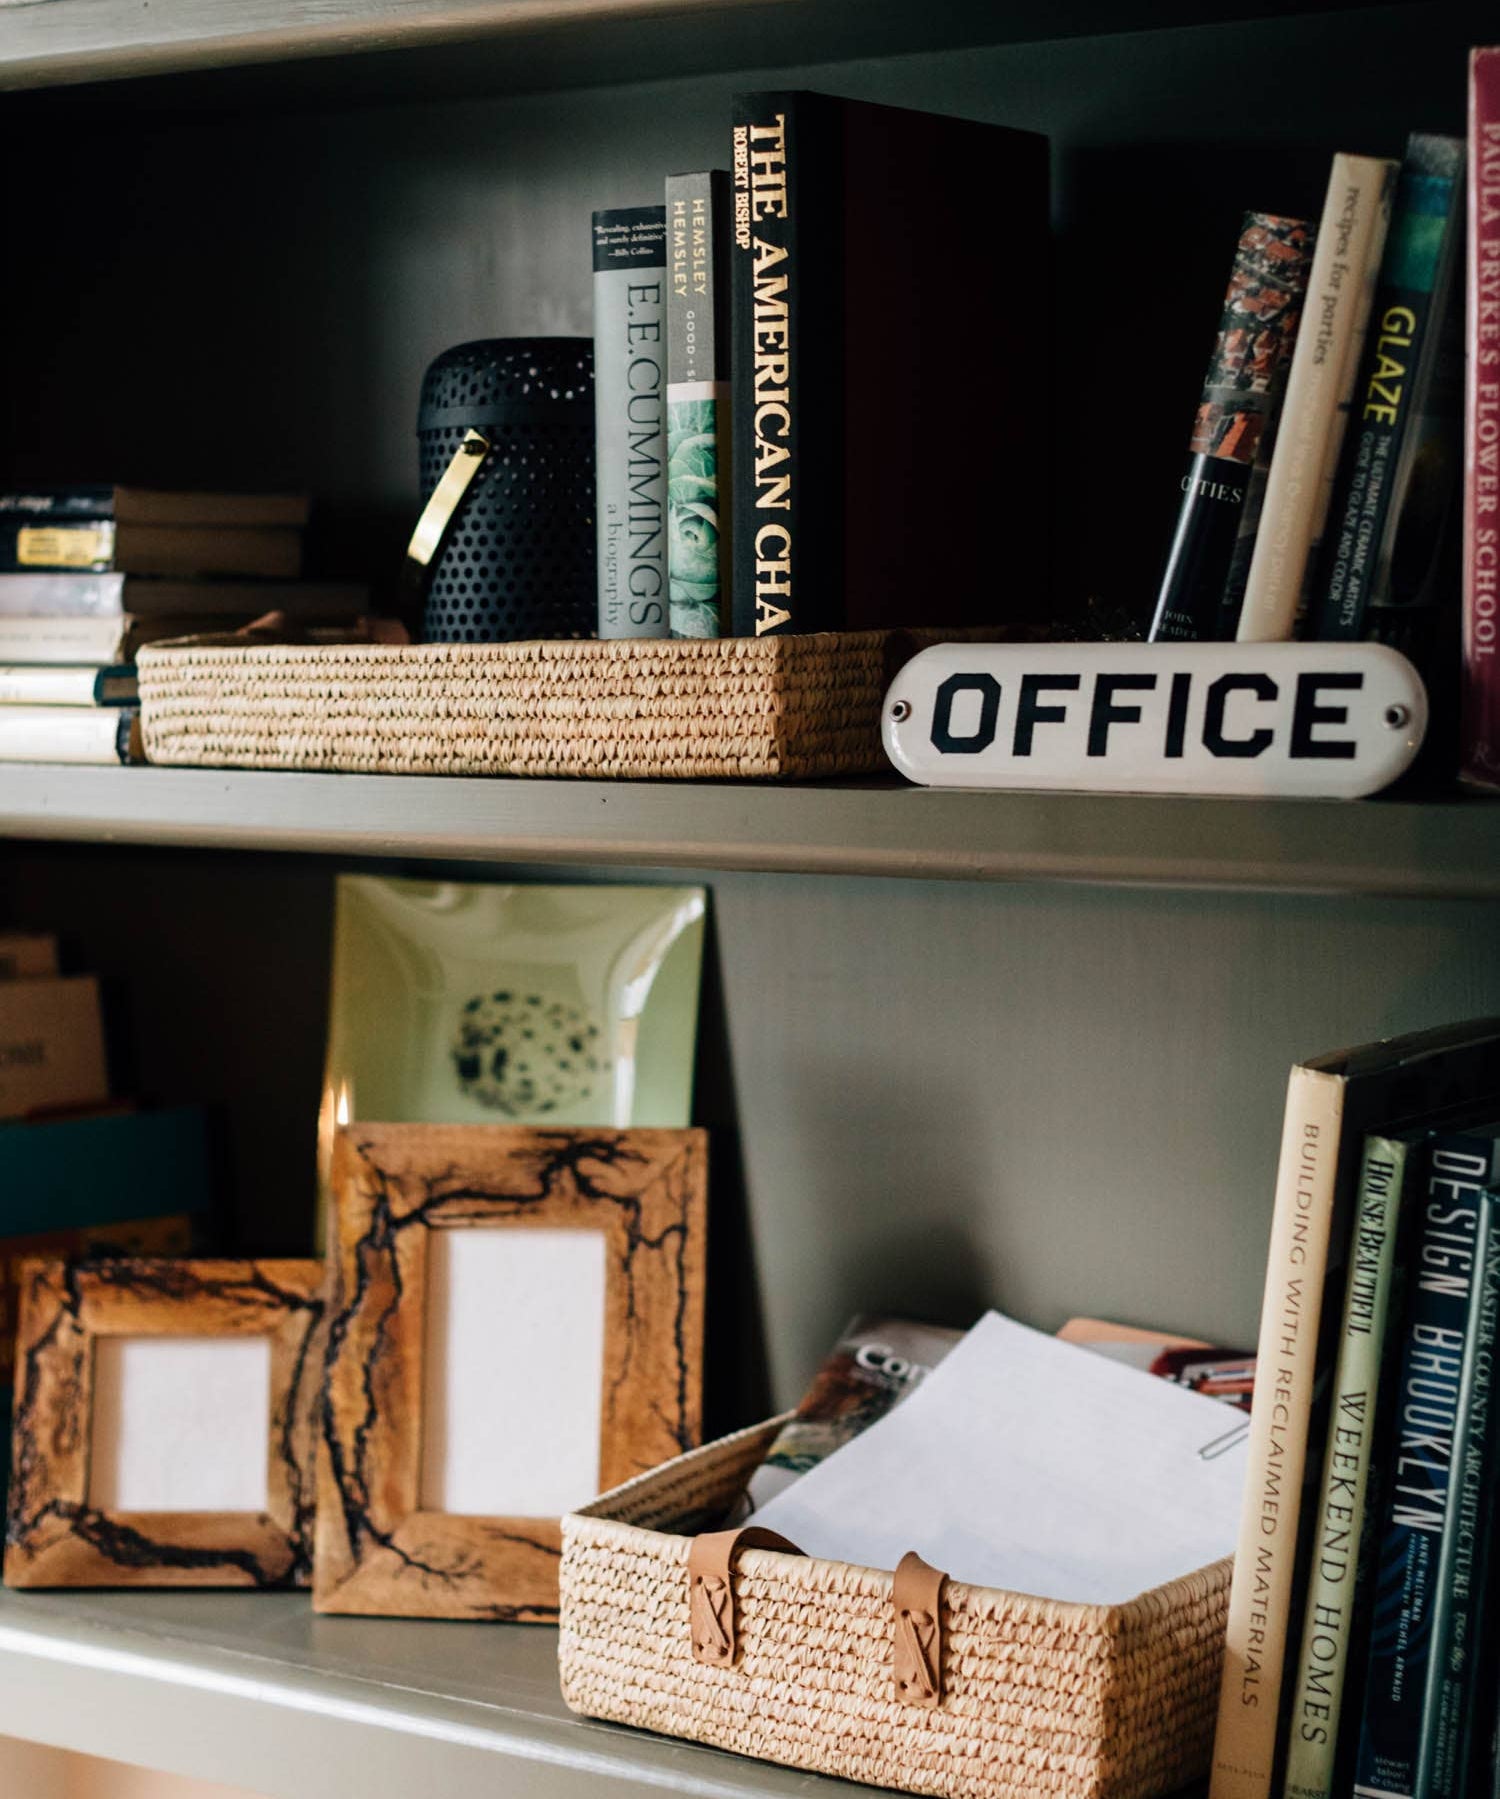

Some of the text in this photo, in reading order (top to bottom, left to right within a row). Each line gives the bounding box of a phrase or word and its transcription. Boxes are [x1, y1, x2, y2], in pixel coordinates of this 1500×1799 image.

[733, 126, 751, 250] ROBERT BISHOP
[750, 114, 787, 221] THE
[1482, 122, 1500, 224] PAULA
[674, 201, 687, 297] HEMSLEY
[692, 199, 706, 295] HEMSLEY
[1313, 186, 1360, 366] recipes for parties
[686, 311, 696, 354] GOOD
[752, 236, 791, 511] AMERICAN
[1363, 306, 1416, 426] GLAZE
[1352, 471, 1367, 489] TO
[1358, 431, 1375, 468] GUIDE
[1362, 460, 1385, 517] ULTIMATE
[1375, 435, 1392, 457] THE
[1476, 383, 1500, 515] FLOWER
[605, 523, 624, 626] biography
[1329, 560, 1347, 602] COLOR
[1337, 531, 1353, 559] AND
[1351, 519, 1374, 575] CERAMIC
[1474, 528, 1497, 662] SCHOOL
[930, 672, 1364, 759] OFFICE
[1392, 1150, 1487, 1533] DESIGN BROOKLYN
[1242, 1122, 1320, 1708] BUILDING WITH RECLAIMED MATERIALS
[1469, 1351, 1493, 1440] COUNTY
[1320, 1391, 1367, 1584] WEEKEND
[1453, 1444, 1483, 1599] ARCHITECTURE
[1412, 1535, 1430, 1622] ANNE HELLMAN
[1302, 1602, 1342, 1745] HOMES
[1391, 1656, 1405, 1702] ARNAUD
